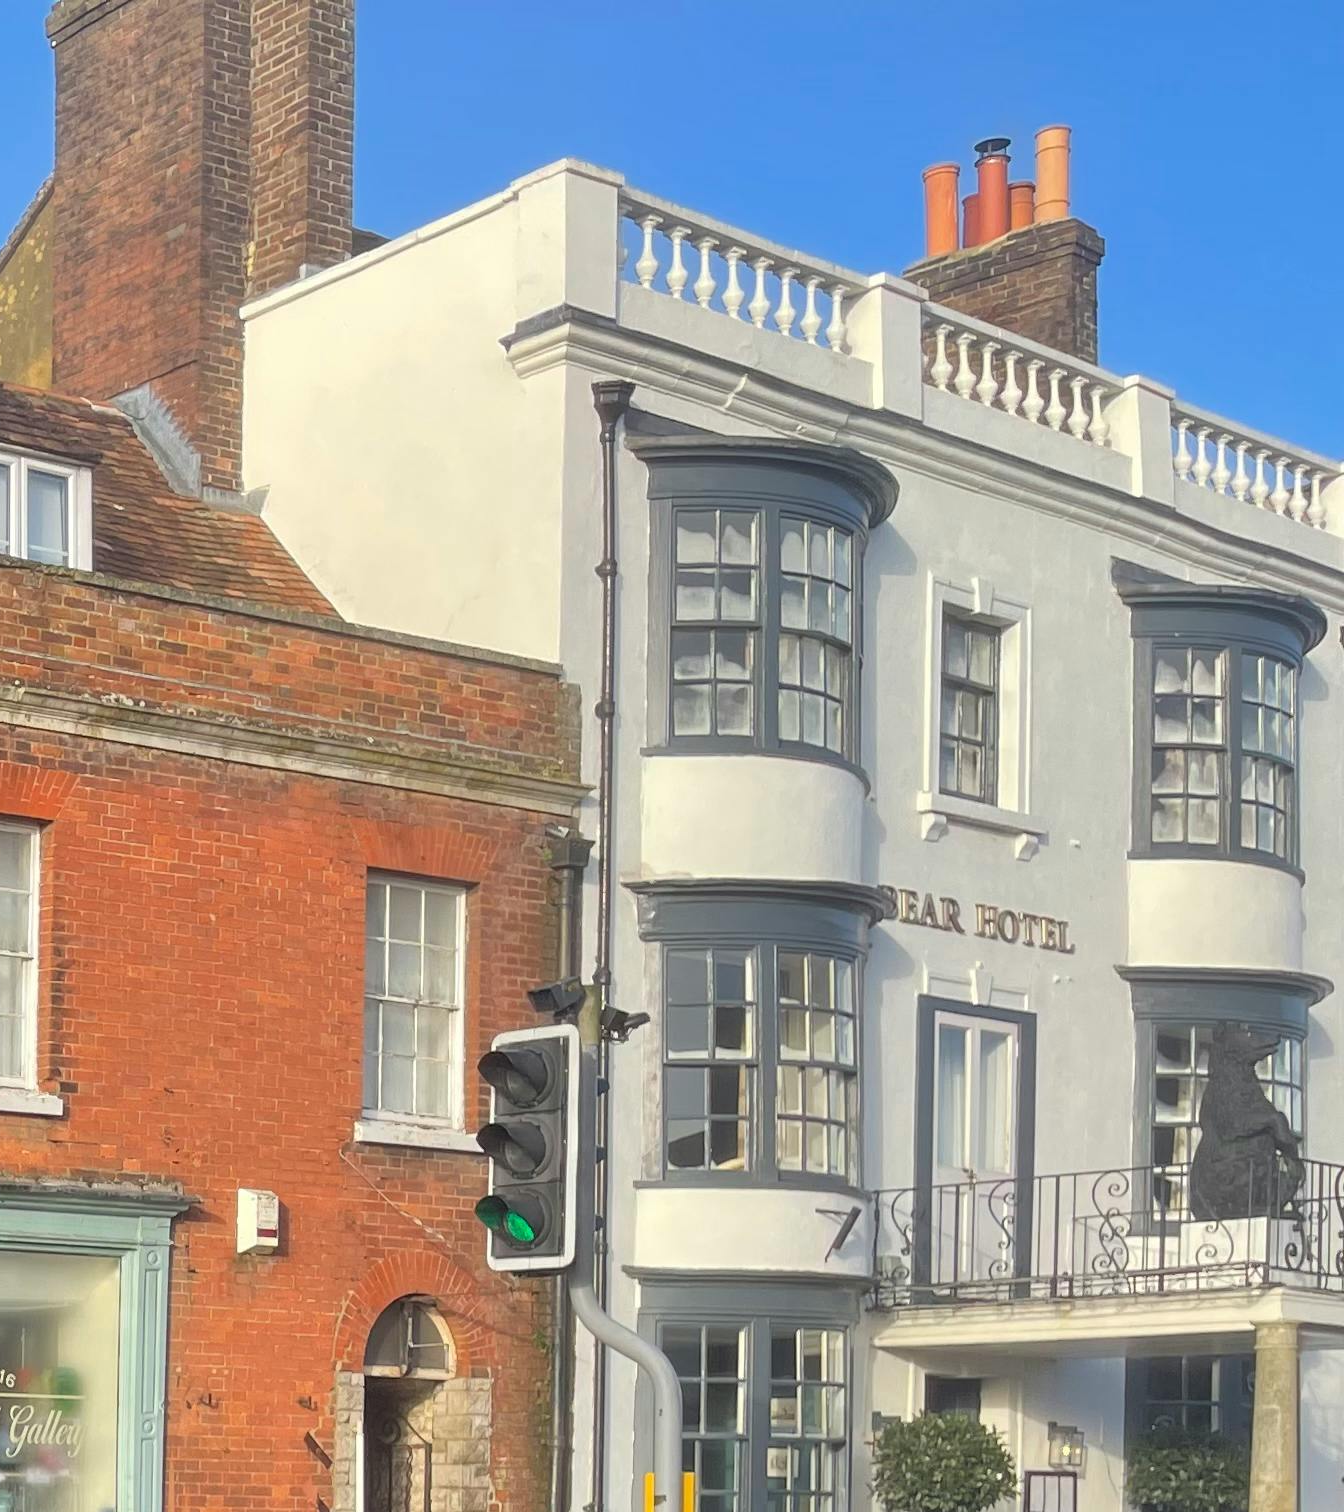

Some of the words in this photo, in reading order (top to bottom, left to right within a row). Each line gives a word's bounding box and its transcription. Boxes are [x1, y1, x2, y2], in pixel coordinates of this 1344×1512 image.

[973, 902, 1076, 954] HOTEL
[0, 1369, 17, 1388] 16
[5, 1404, 87, 1457] Gallery
